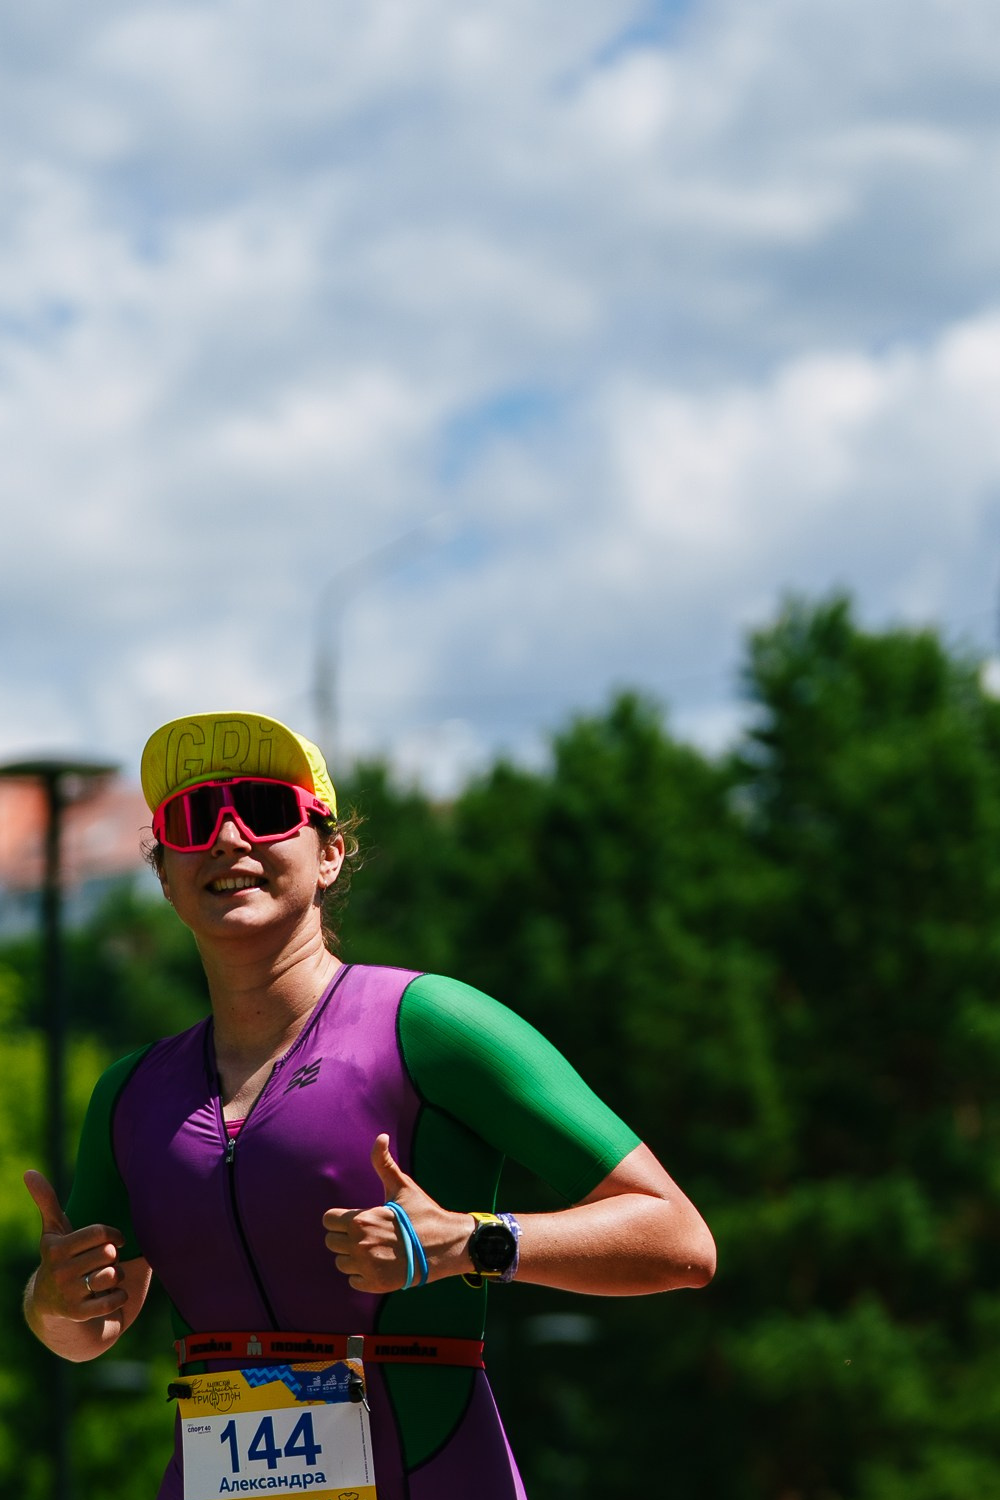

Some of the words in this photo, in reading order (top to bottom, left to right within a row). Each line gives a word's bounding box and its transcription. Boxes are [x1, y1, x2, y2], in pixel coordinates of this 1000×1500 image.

[271, 1338, 334, 1353] IRONMAN
[375, 1341, 438, 1356] IRONMAN
[219, 1412, 322, 1473] 144
[219, 1471, 327, 1493] Александра
